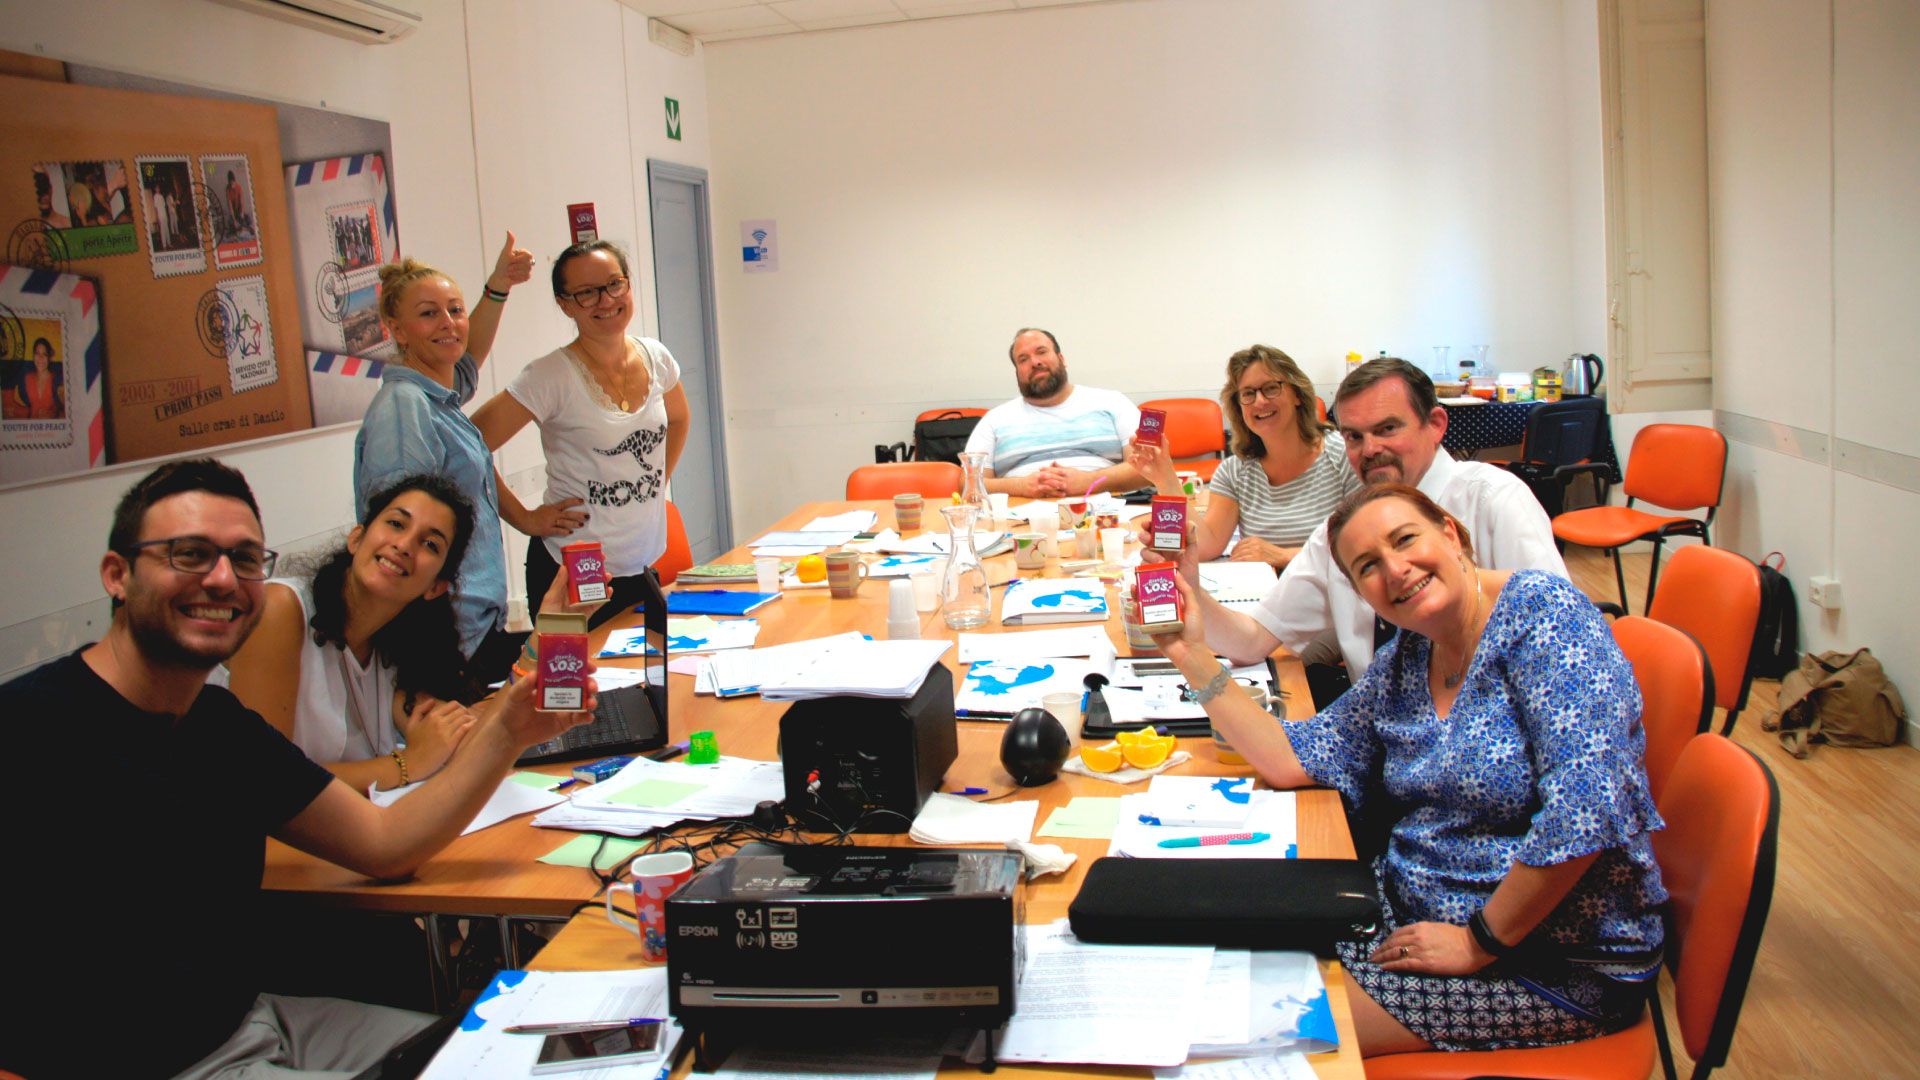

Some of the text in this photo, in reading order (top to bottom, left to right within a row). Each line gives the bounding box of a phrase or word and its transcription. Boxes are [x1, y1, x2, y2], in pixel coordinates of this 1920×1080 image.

[155, 254, 174, 263] YOUTH
[175, 253, 185, 262] FOR
[235, 359, 271, 374] SERVIZIO CIVILE
[240, 367, 268, 380] NAZIONALE
[119, 382, 156, 403] 2003
[162, 398, 193, 418] PRIMI
[195, 386, 222, 406] PASSI
[3, 422, 66, 432] YOUTH FOR PEACE
[179, 408, 285, 437] Sulle orme di Danilo
[1158, 512, 1183, 523] LOS?
[577, 560, 601, 573] LOS?
[1144, 581, 1175, 595] LOS?
[549, 660, 584, 673] LOS?
[679, 925, 719, 937] EPSON
[770, 931, 798, 941] DVD
